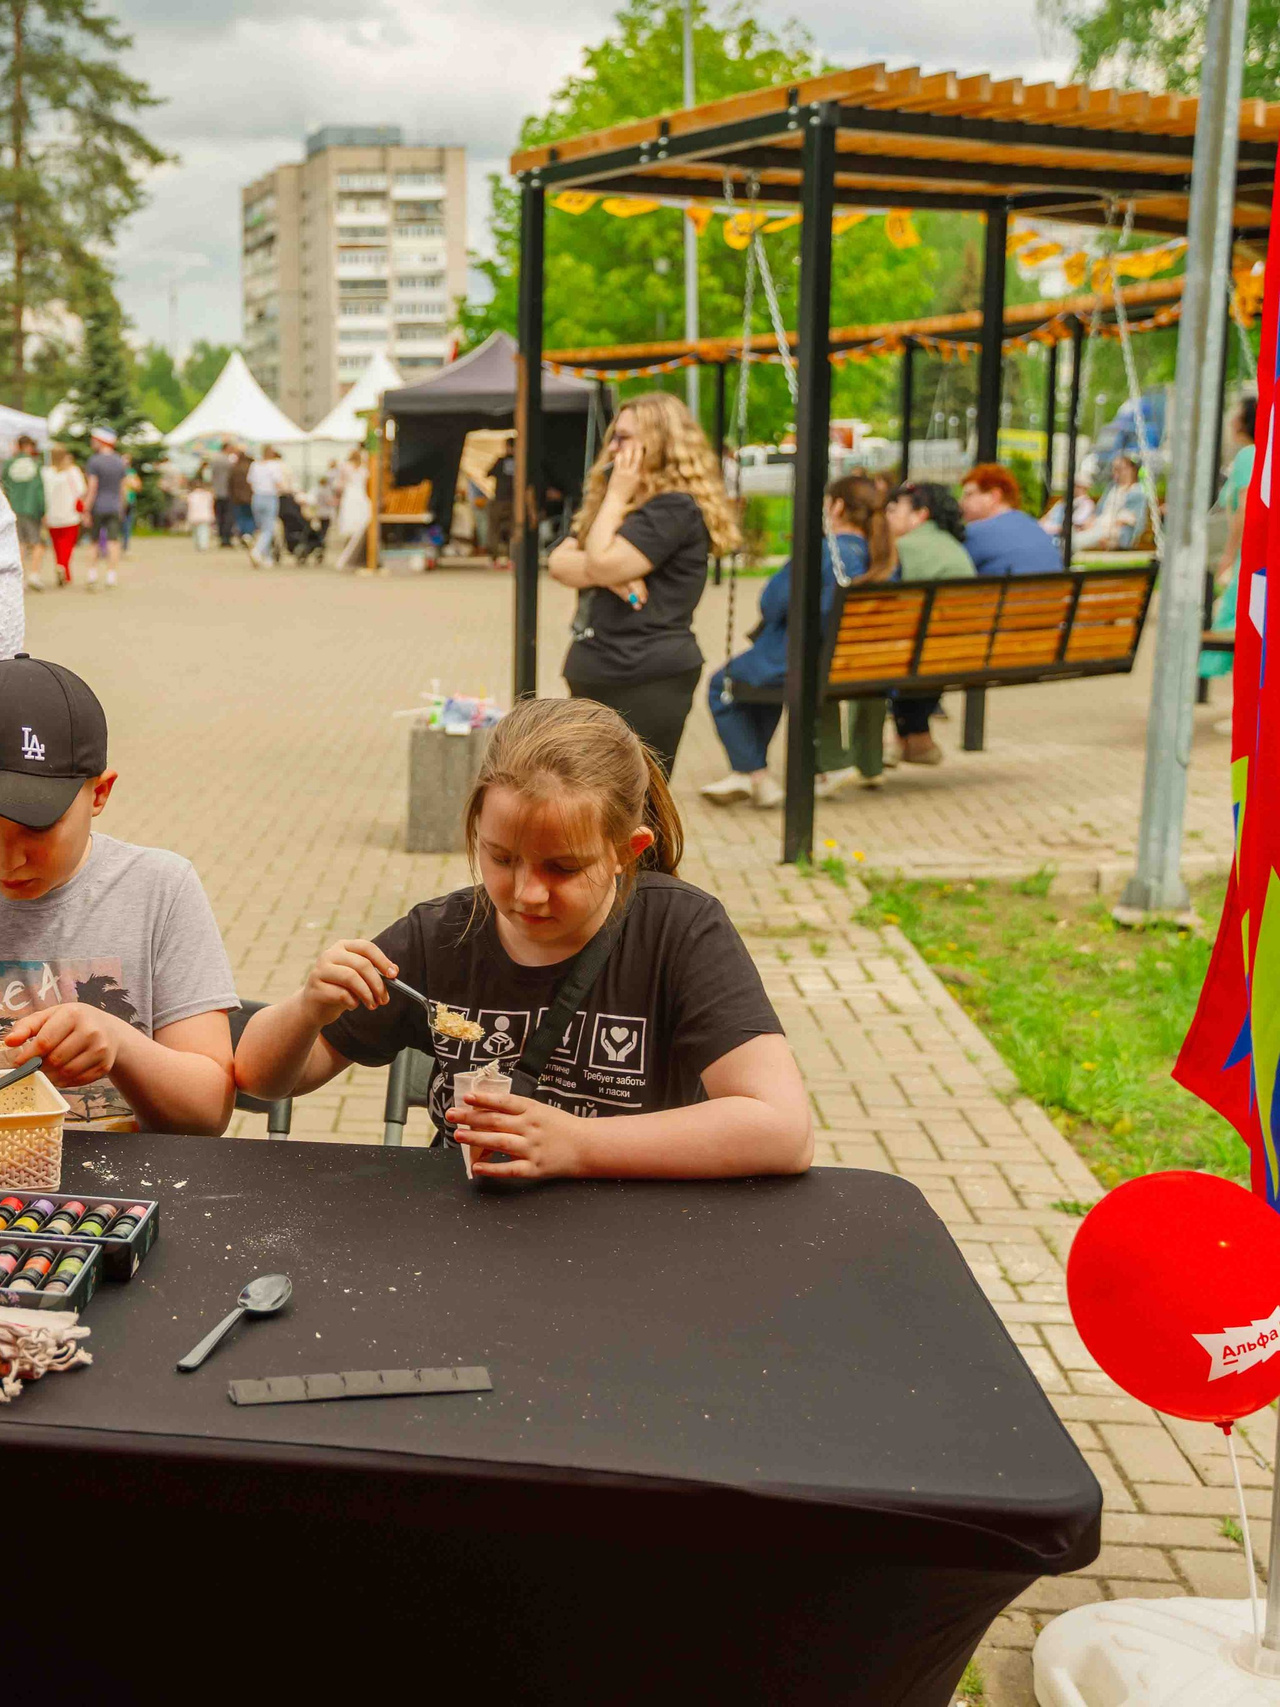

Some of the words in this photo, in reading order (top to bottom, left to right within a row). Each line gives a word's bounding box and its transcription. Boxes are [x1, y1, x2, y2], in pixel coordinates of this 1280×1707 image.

[21, 726, 46, 761] LA
[37, 961, 63, 1004] A
[583, 1069, 615, 1085] Требует
[615, 1075, 647, 1087] заботы
[598, 1086, 604, 1094] и
[605, 1087, 631, 1098] ласки
[1222, 1329, 1279, 1361] Альфа
